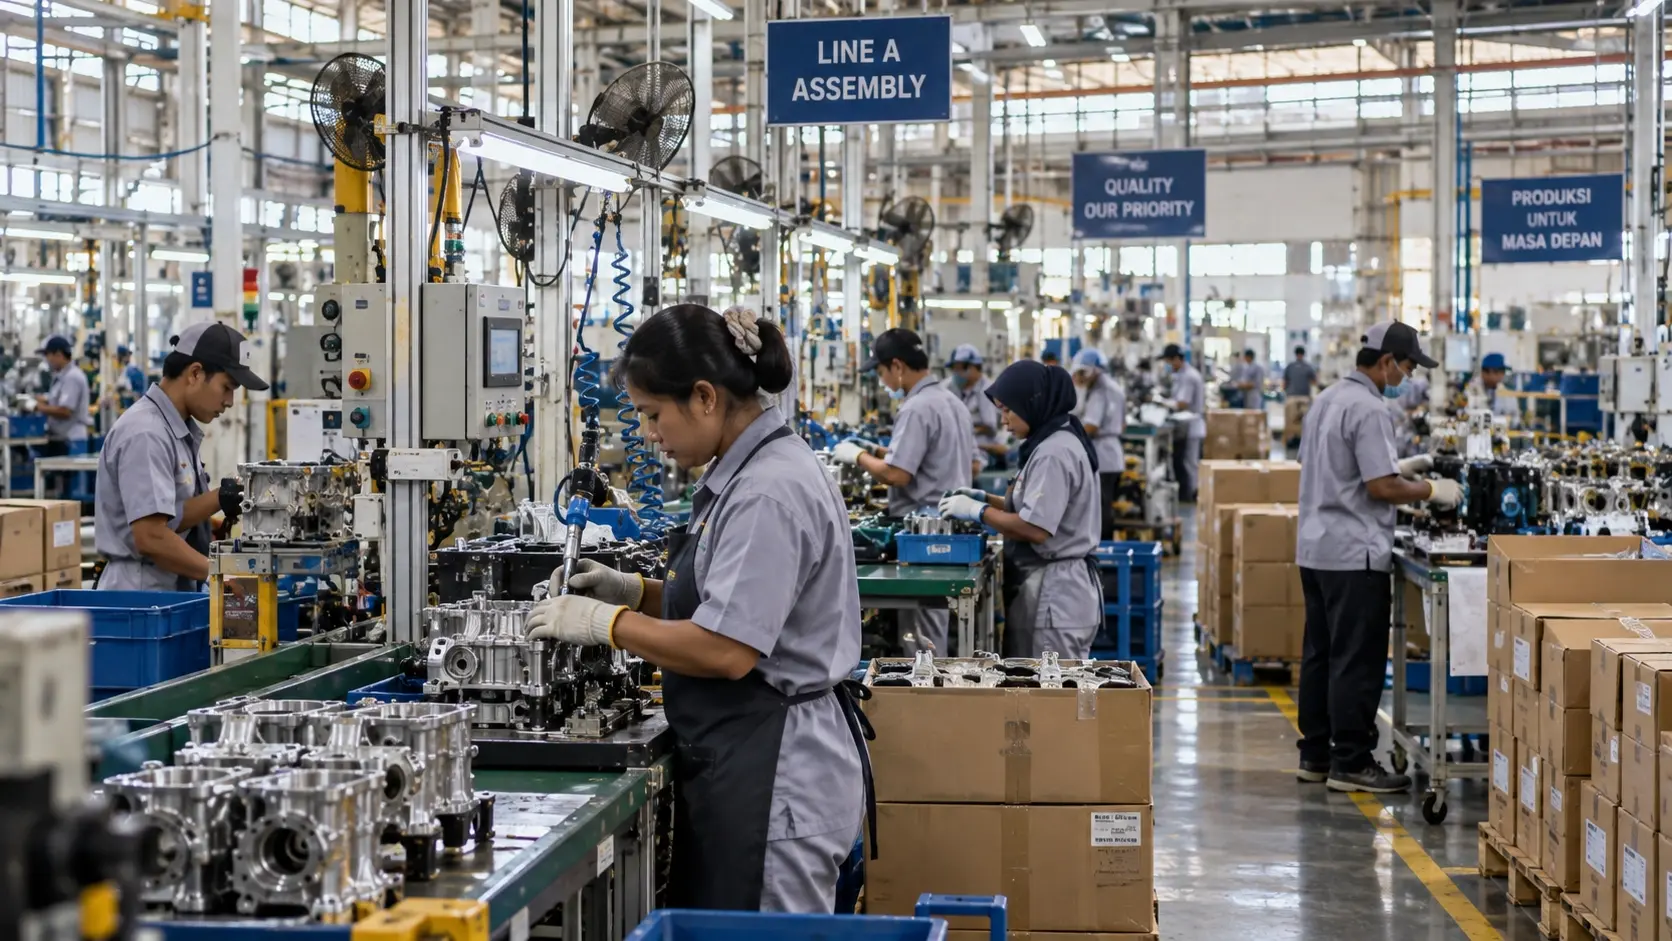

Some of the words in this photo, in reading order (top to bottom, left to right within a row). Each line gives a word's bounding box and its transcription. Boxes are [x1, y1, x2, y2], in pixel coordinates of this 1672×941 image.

[818, 39, 874, 64] LINE
[882, 38, 901, 63] A
[792, 74, 927, 102] ASSEMBLY
[1104, 177, 1174, 196] QUALITY
[1512, 187, 1592, 206] PRODUKSI
[1084, 201, 1118, 219] OUR
[1122, 200, 1195, 218] PRIORITY
[1527, 211, 1577, 228] UNTUK
[1502, 233, 1547, 250] MASA
[1551, 231, 1603, 249] DEPAN
